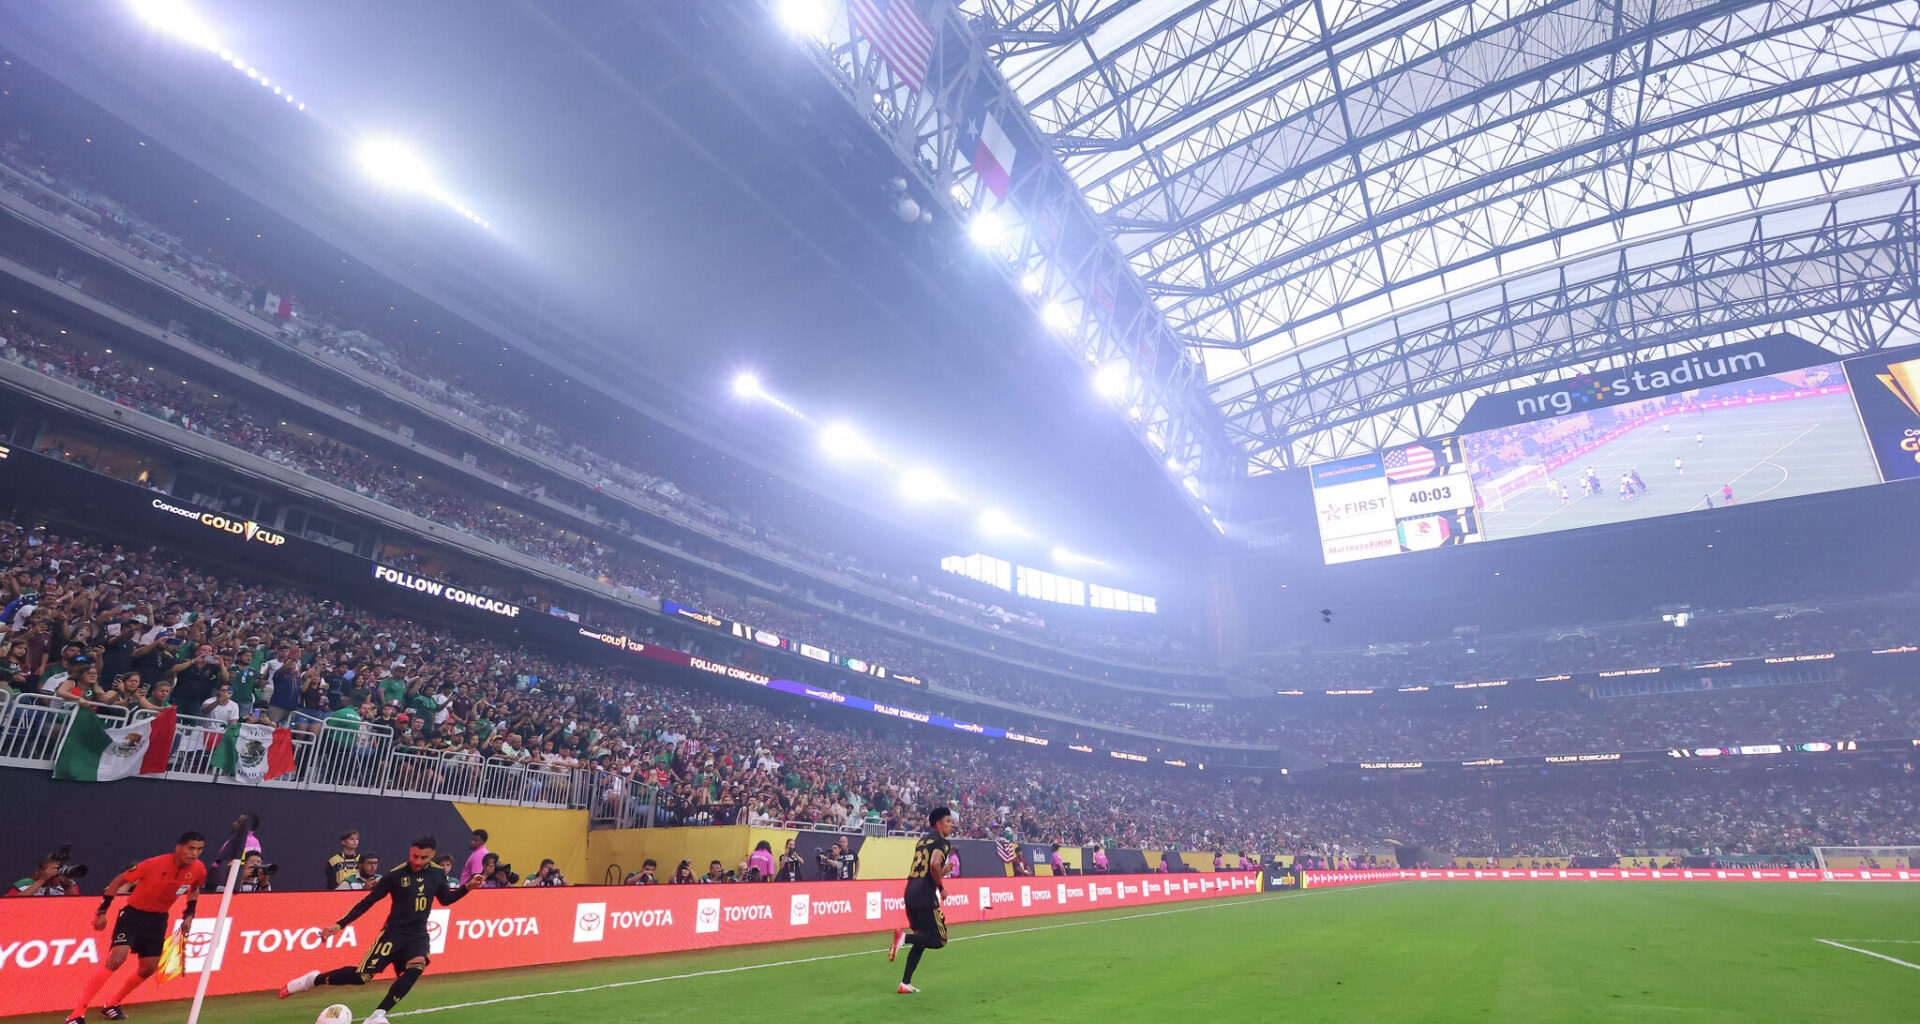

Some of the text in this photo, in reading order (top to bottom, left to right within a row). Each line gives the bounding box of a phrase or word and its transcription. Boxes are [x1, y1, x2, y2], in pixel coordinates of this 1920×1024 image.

[1517, 351, 1766, 415] nrg stadium
[1442, 446, 1454, 463] 1
[1409, 486, 1452, 504] 40:03
[1344, 497, 1387, 514] FIRST
[152, 499, 286, 546] Concacaf GOLD CUP
[1456, 515, 1469, 534] 1
[374, 565, 520, 618] FOLLOW CONCACAF
[601, 633, 621, 646] GOLD
[629, 641, 644, 652] CUP
[1796, 653, 1836, 662] CONCACAF
[690, 656, 770, 686] FOLLOW CONCACAF
[873, 703, 930, 722] FOLLOW CONCACAF
[1579, 753, 1621, 762] CONCACAF
[911, 848, 930, 878] 23
[991, 892, 1014, 903] TOYOTA
[1031, 890, 1052, 900] TOYOTA
[415, 897, 427, 912] 10
[724, 905, 772, 922] TOYOTA
[812, 900, 852, 915] TOYOTA
[610, 909, 673, 929] TOYOTA
[456, 917, 539, 940] TOYOTA
[375, 941, 393, 956] 10
